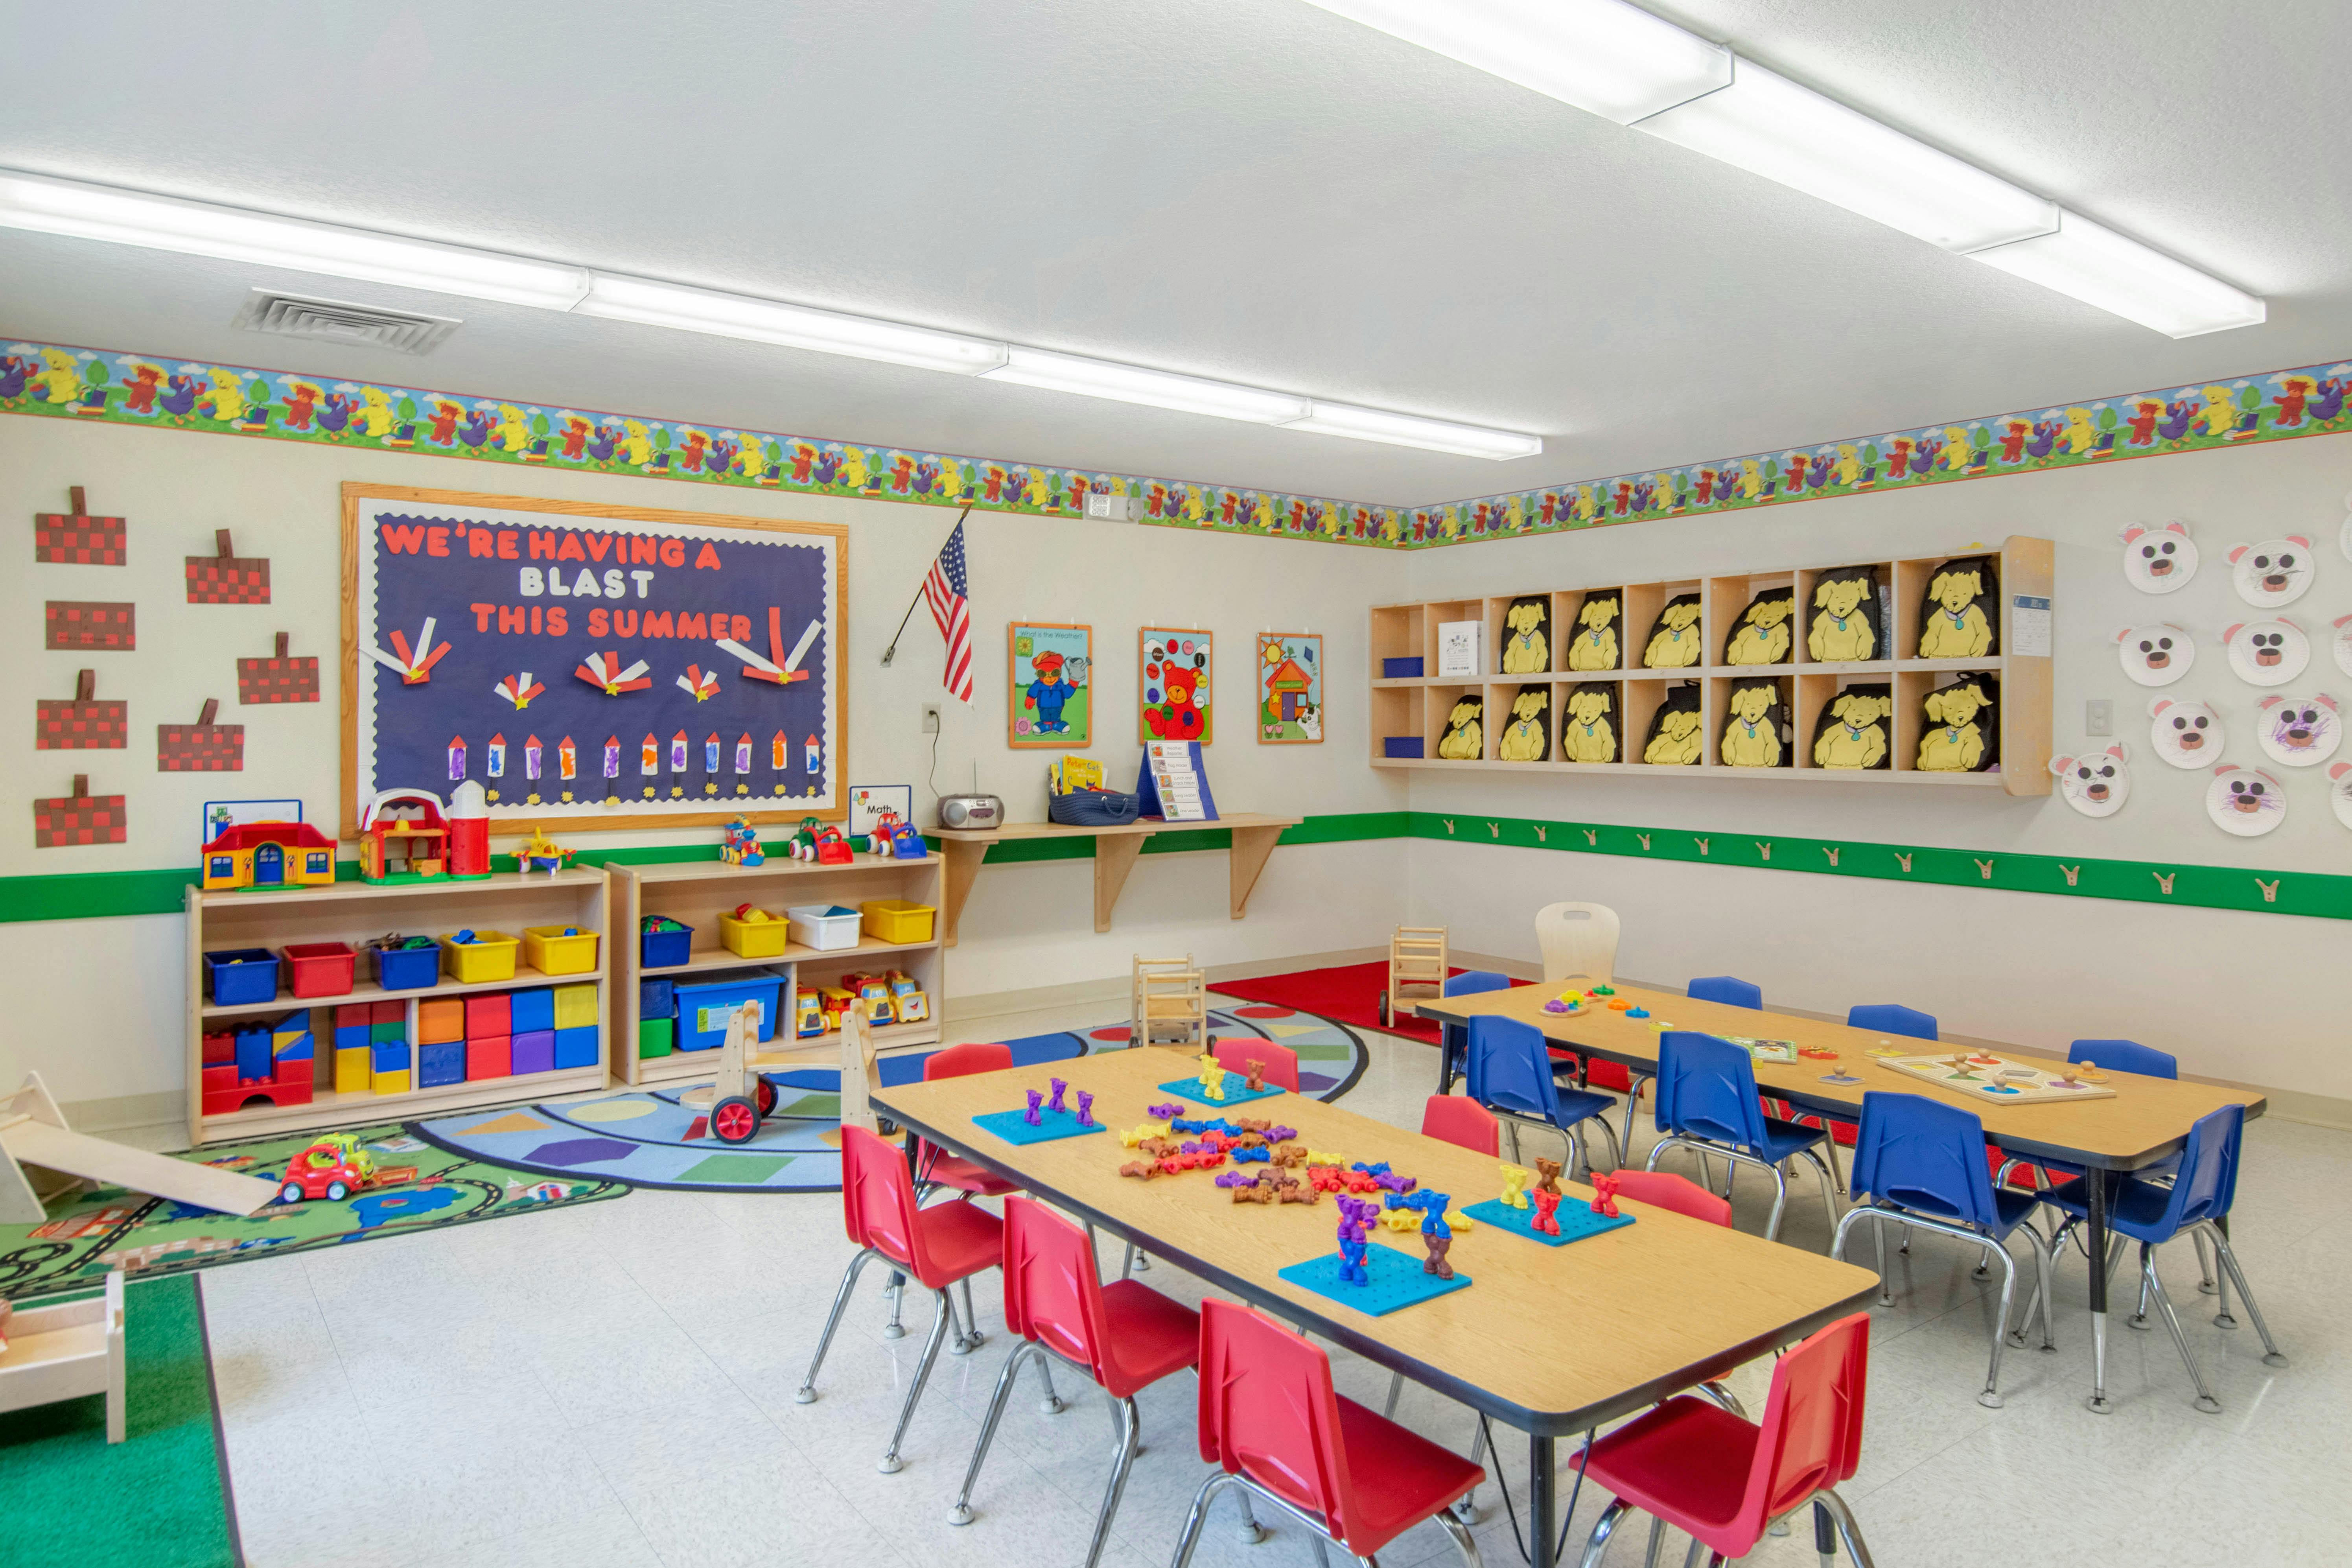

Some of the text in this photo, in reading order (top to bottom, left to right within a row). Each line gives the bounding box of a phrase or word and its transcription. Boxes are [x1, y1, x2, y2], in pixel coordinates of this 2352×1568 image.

[381, 522, 721, 570] WE'RE HAVING A
[520, 567, 654, 599] BLAST
[470, 603, 751, 642] THIS SUMMER
[1067, 757, 1082, 768] Pete
[1087, 762, 1100, 771] Cat
[867, 805, 892, 814] Math
